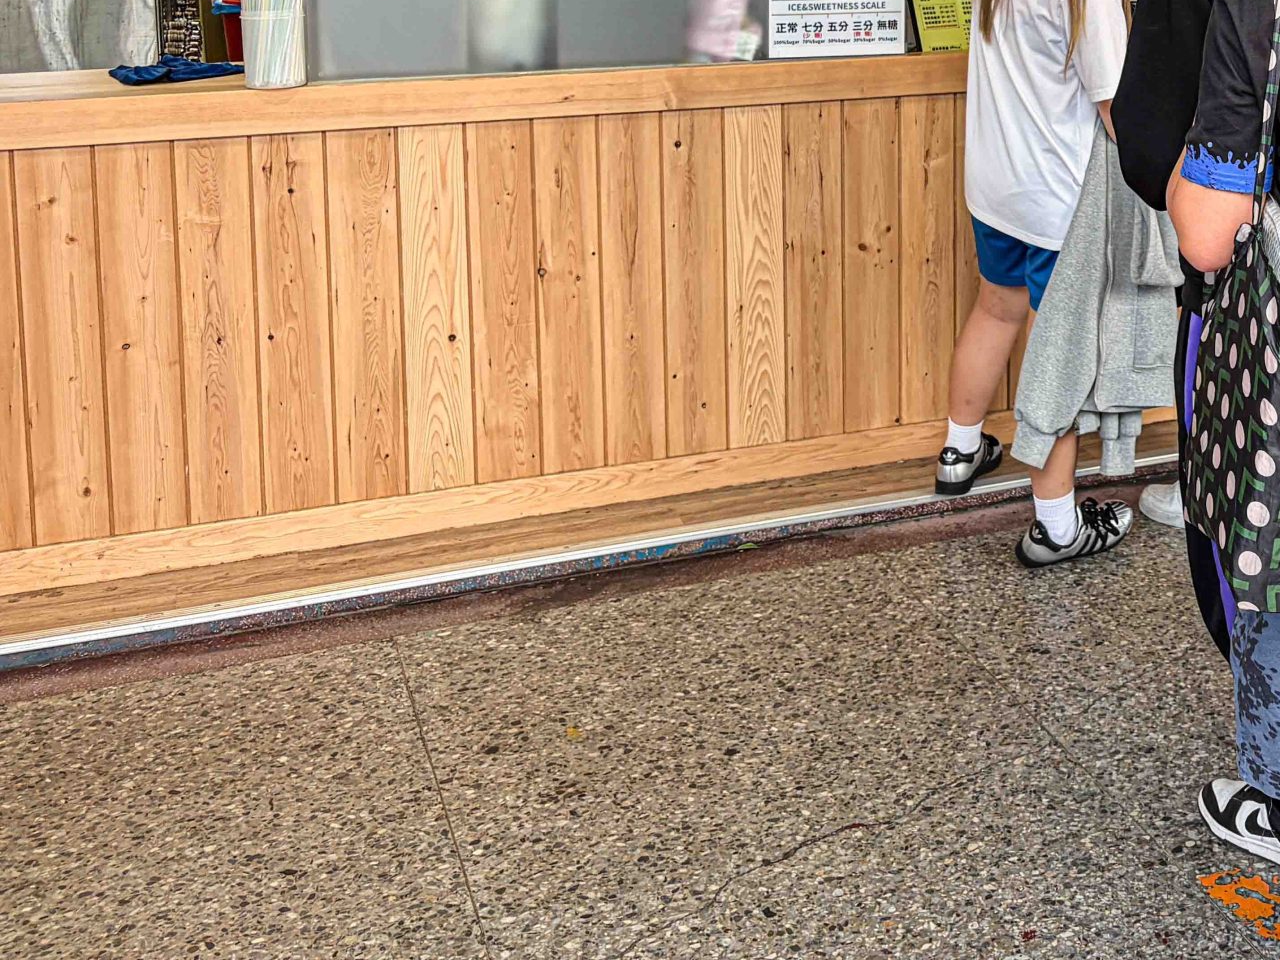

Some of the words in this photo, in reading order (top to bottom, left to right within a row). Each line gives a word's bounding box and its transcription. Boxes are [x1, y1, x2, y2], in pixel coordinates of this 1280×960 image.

[788, 3, 858, 11] ICE&SWEETNESS
[776, 22, 797, 33] 正常
[802, 22, 823, 32] 七分
[828, 21, 848, 32] 五分
[852, 20, 873, 30] 三分
[877, 20, 898, 30] 無糖
